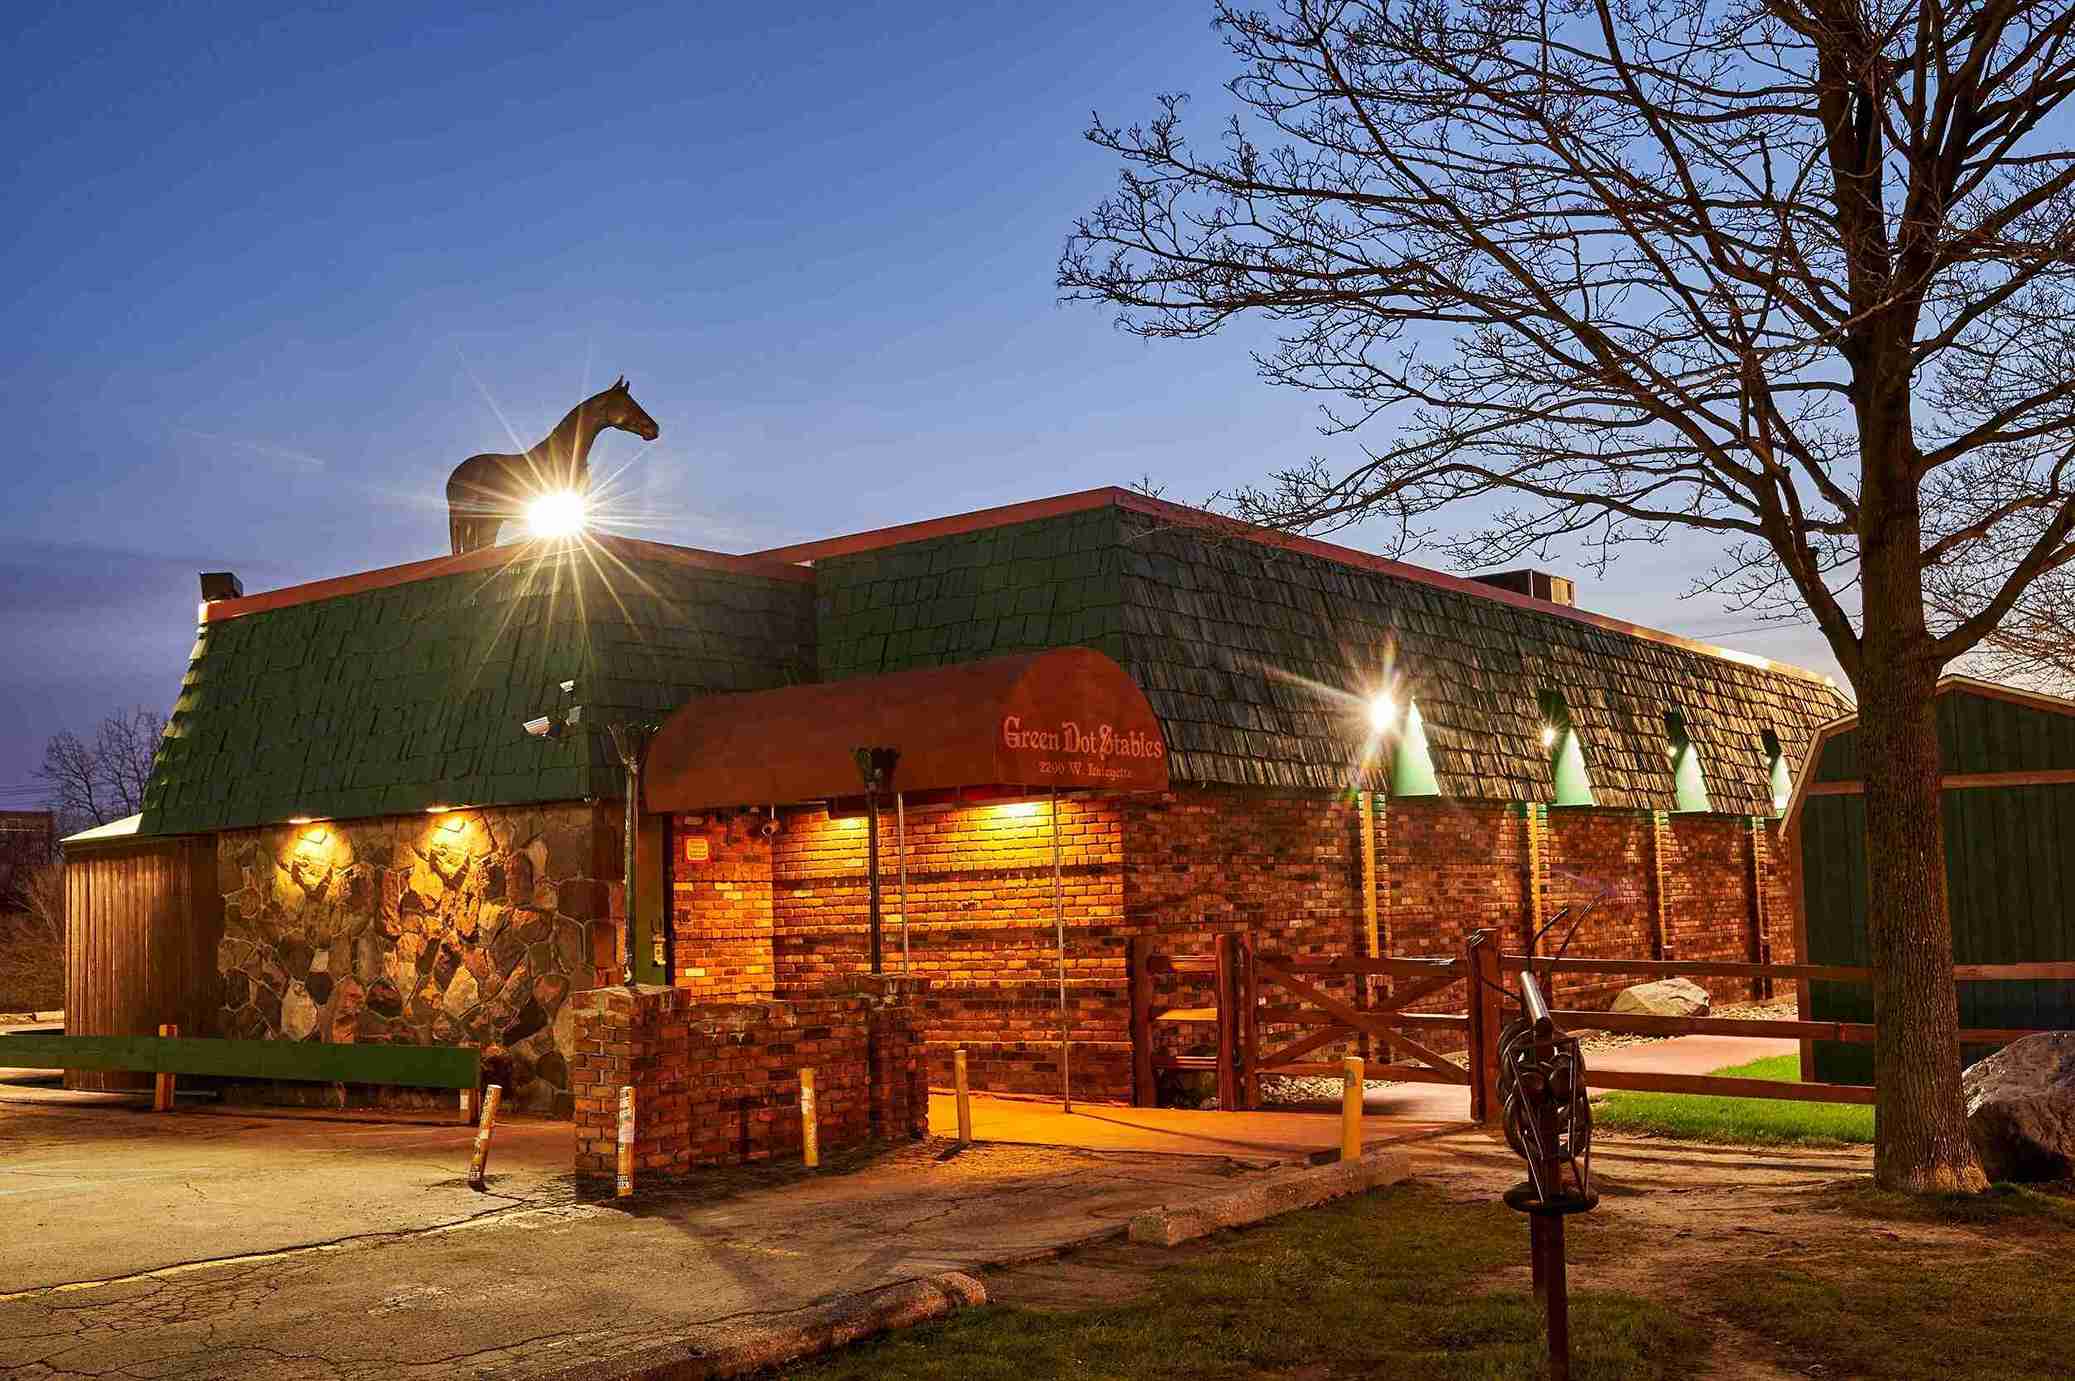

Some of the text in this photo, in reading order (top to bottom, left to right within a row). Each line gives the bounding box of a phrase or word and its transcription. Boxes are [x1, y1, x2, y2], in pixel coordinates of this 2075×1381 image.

[1003, 716, 1163, 760] Green Dot Stables
